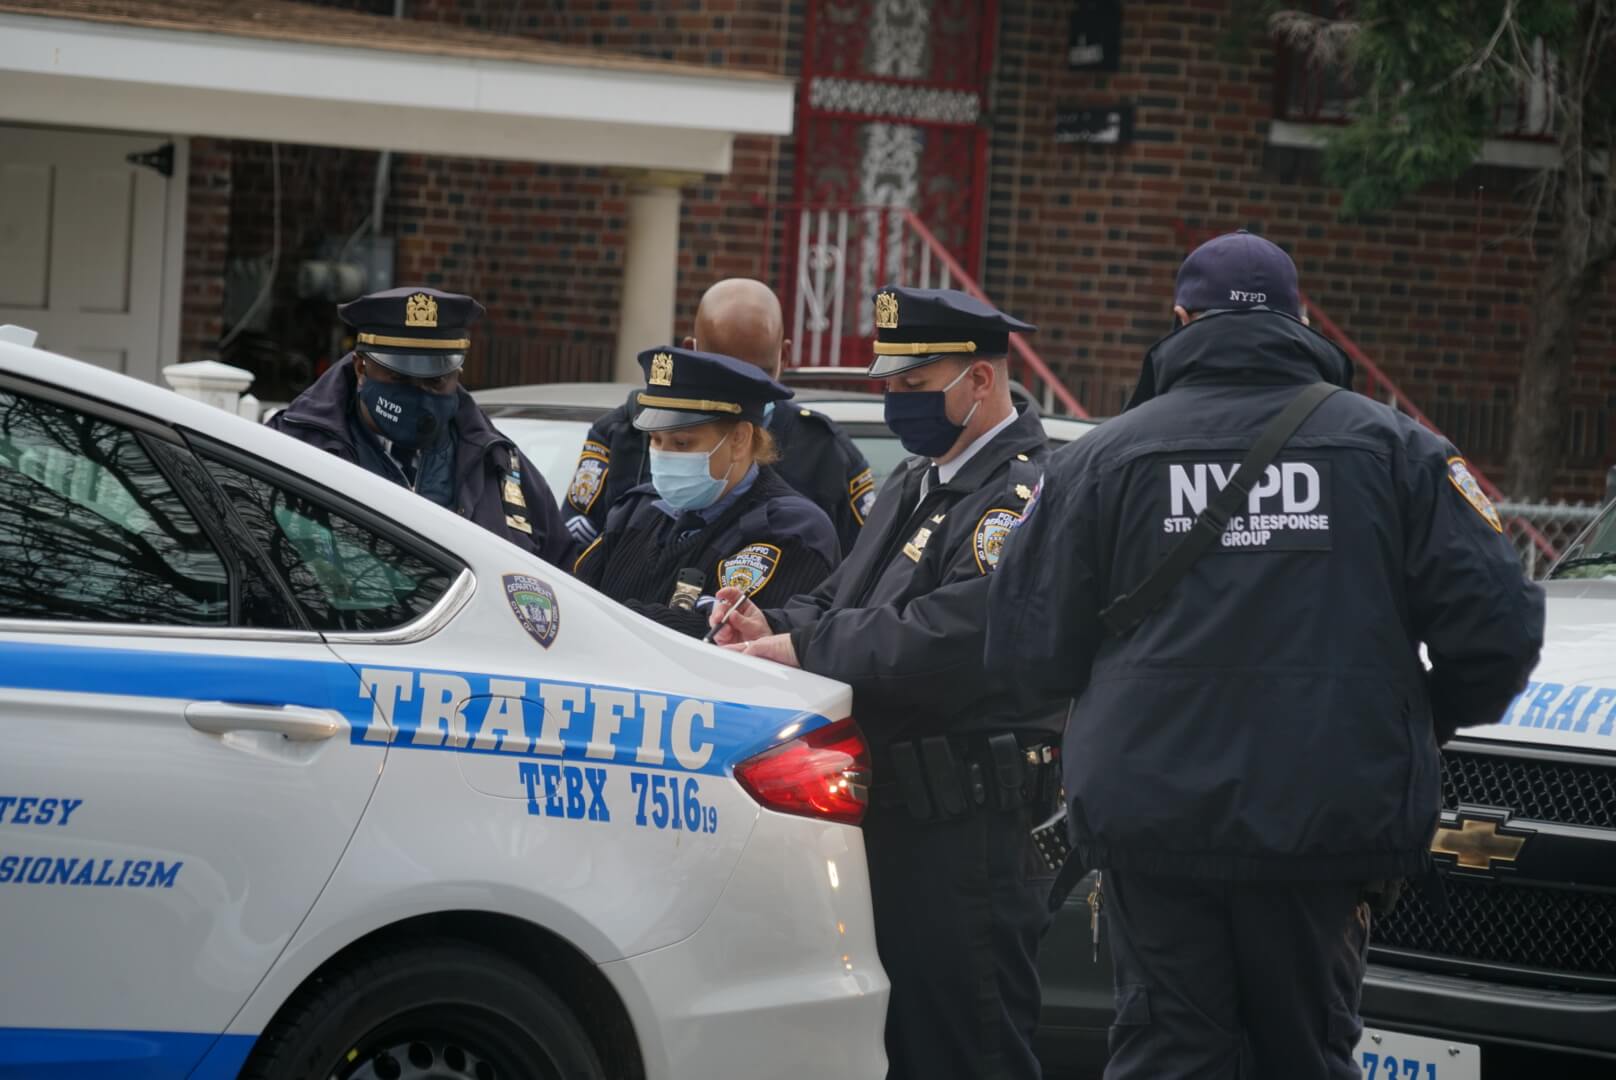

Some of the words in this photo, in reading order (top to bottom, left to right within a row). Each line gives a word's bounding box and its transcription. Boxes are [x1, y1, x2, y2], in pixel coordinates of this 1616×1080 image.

[1229, 290, 1267, 303] NYPD
[377, 396, 402, 414] NYPD
[1163, 516, 1245, 533] STRIC
[1251, 514, 1329, 531] RESPONSE
[1221, 530, 1272, 547] GROUP
[359, 668, 715, 770] TRAFFIC
[519, 761, 610, 822] TEBX
[630, 772, 701, 833] 7516
[0, 856, 184, 888] SIONALISM
